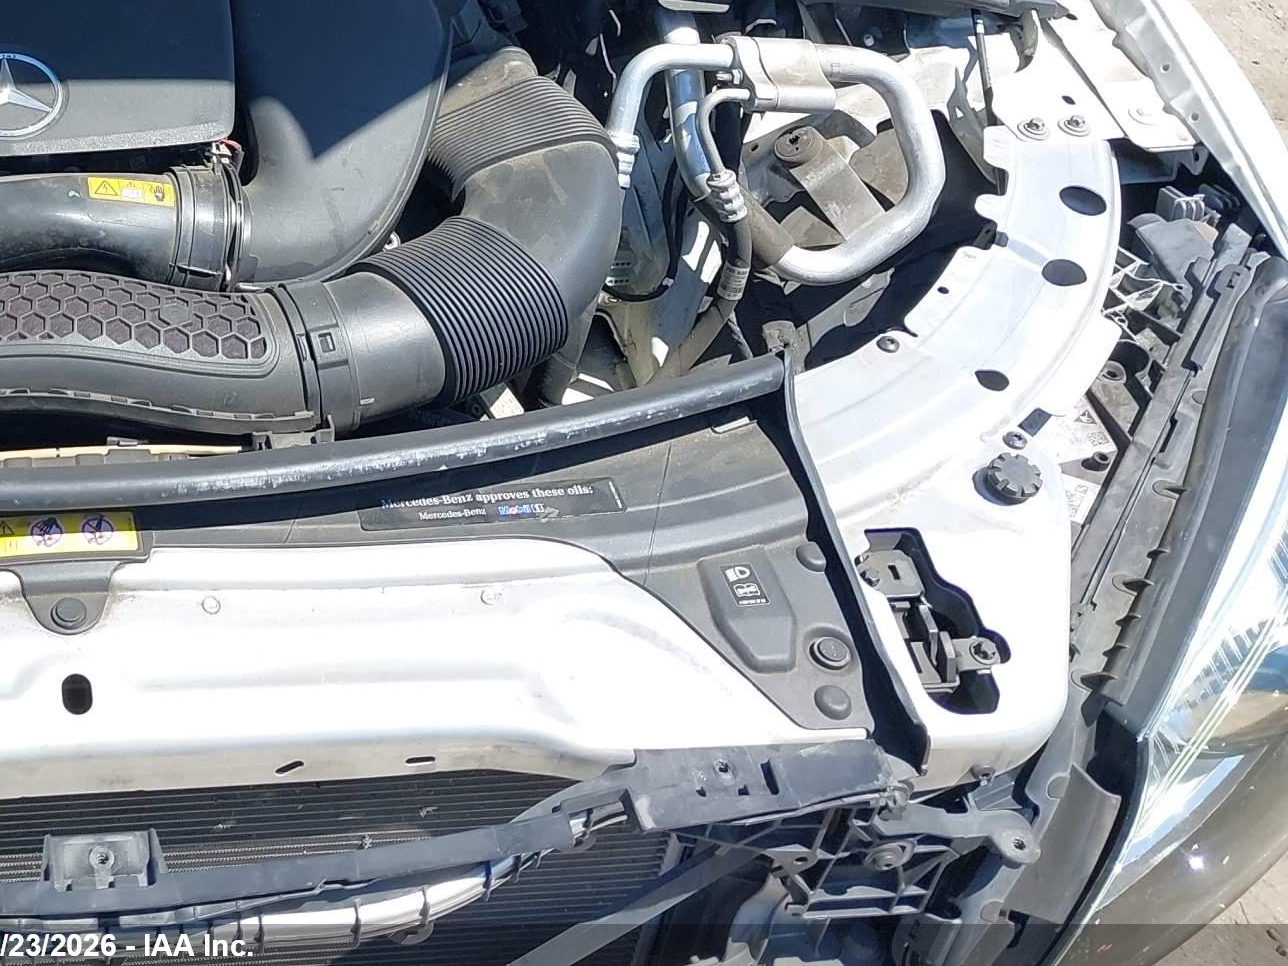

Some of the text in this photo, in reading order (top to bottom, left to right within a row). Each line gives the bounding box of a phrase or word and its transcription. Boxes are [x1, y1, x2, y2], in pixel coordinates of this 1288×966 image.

[381, 484, 594, 509] Mercedes-Benz approves these oils:
[419, 508, 487, 521] Mercedes-Benz
